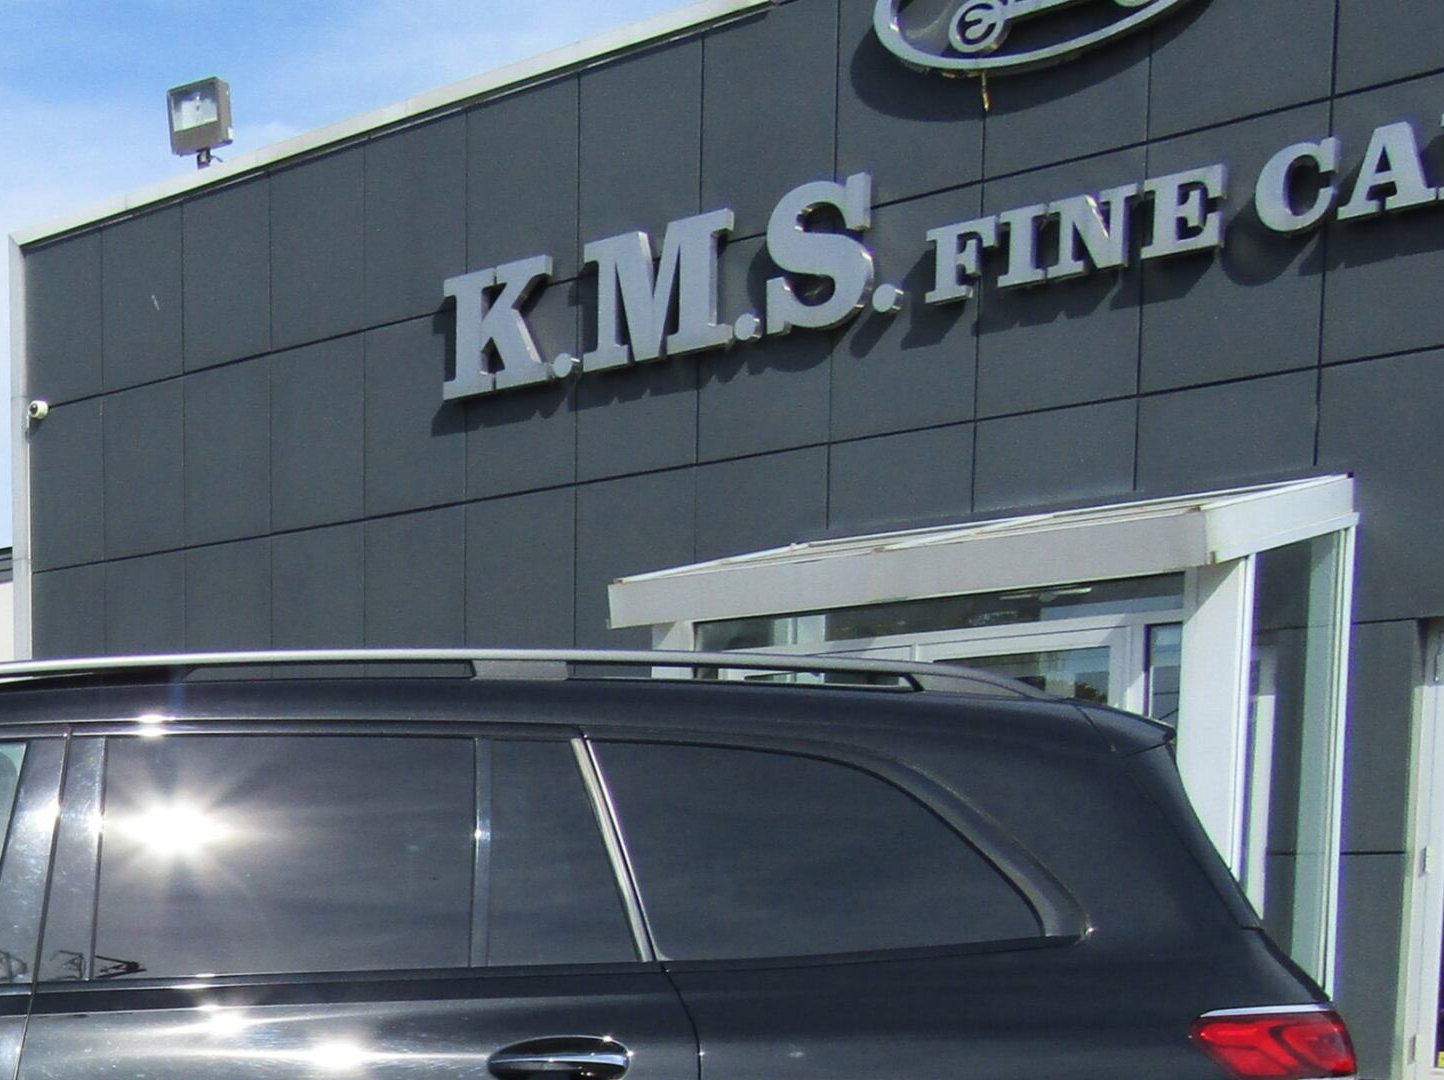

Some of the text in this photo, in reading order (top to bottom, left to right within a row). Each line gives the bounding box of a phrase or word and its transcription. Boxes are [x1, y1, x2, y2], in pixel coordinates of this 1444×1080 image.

[443, 113, 1444, 400] K.M.S. FINE CA
